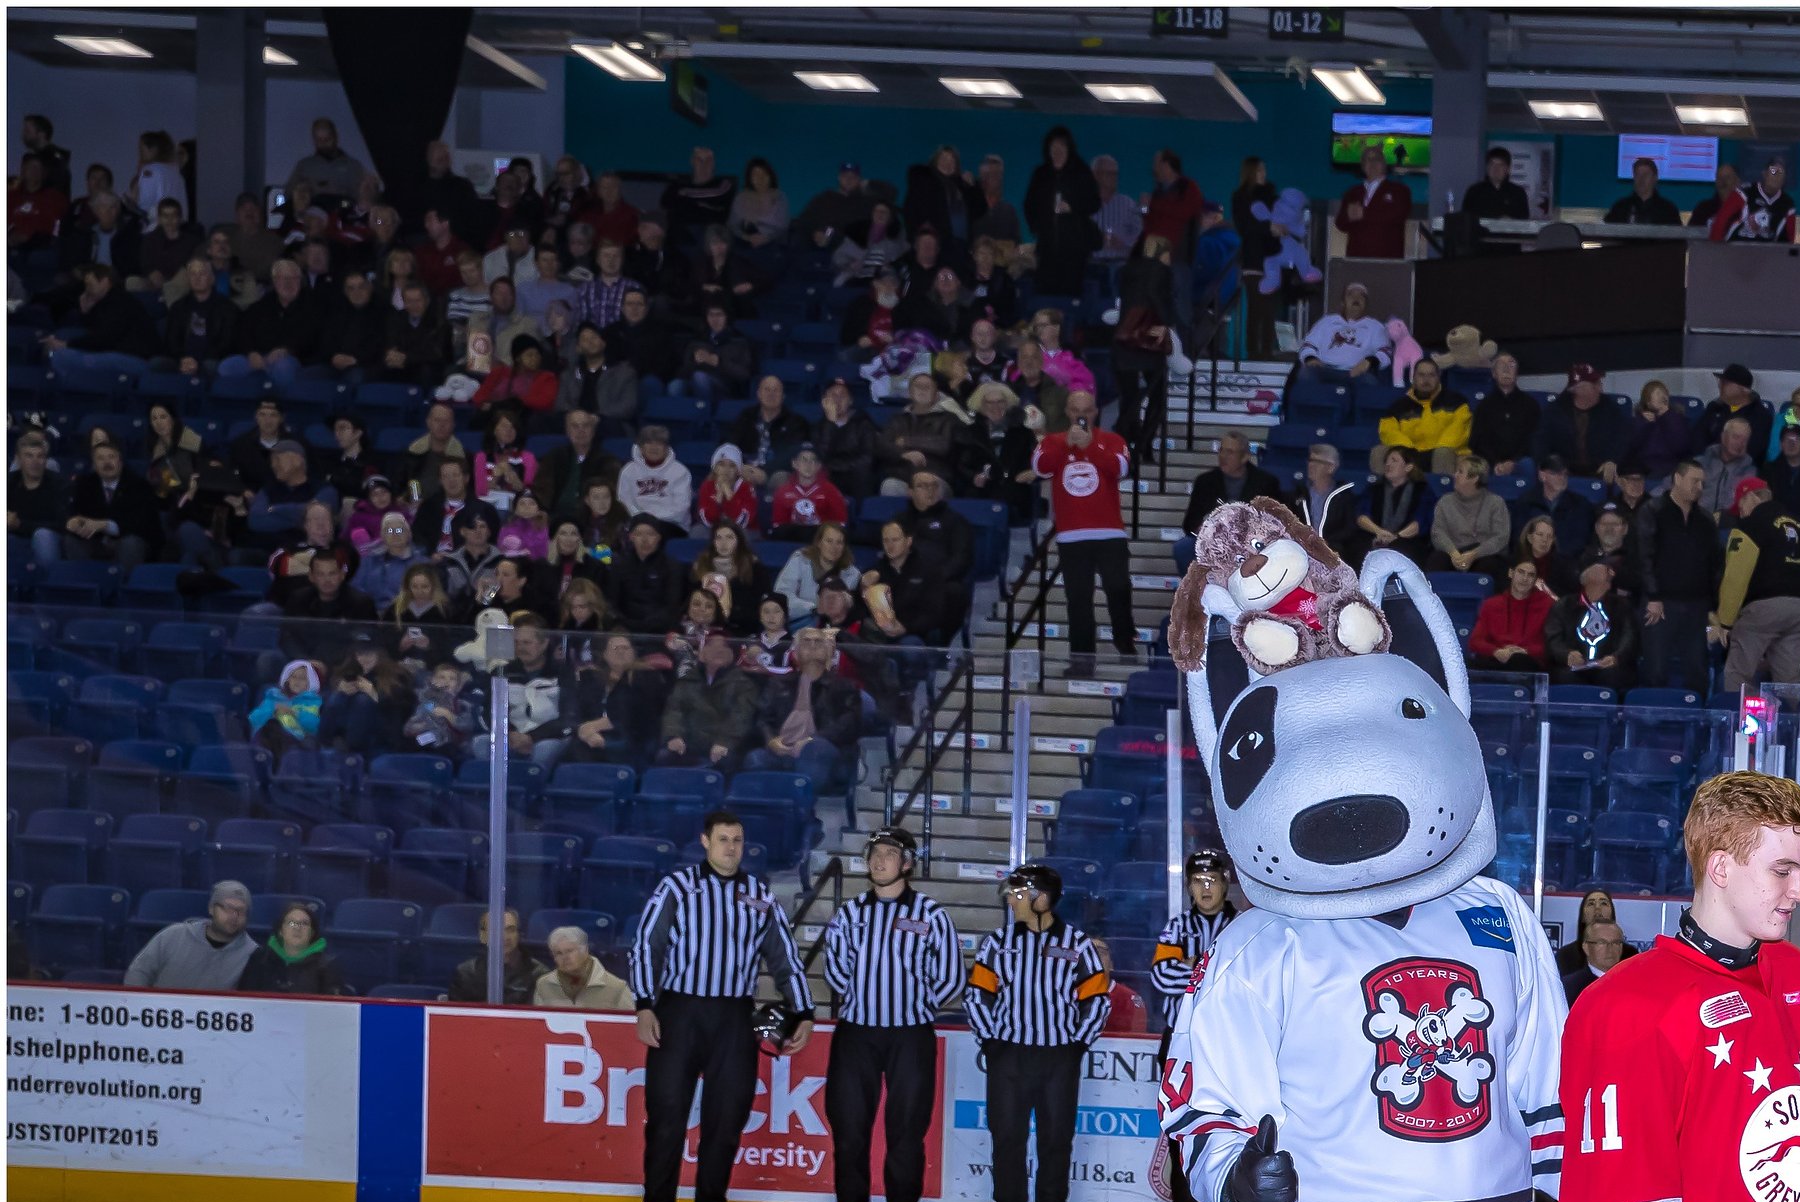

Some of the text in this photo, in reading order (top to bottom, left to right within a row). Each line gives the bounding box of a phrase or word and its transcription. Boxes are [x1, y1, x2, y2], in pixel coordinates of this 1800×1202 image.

[1176, 8, 1224, 29] 11-18
[1273, 11, 1322, 33] 01-12
[1385, 968, 1459, 986] 10 YEARS
[61, 1003, 254, 1033] 1-800-668-6868
[1395, 1106, 1481, 1128] 2007 2017
[1580, 1084, 1623, 1154] 11
